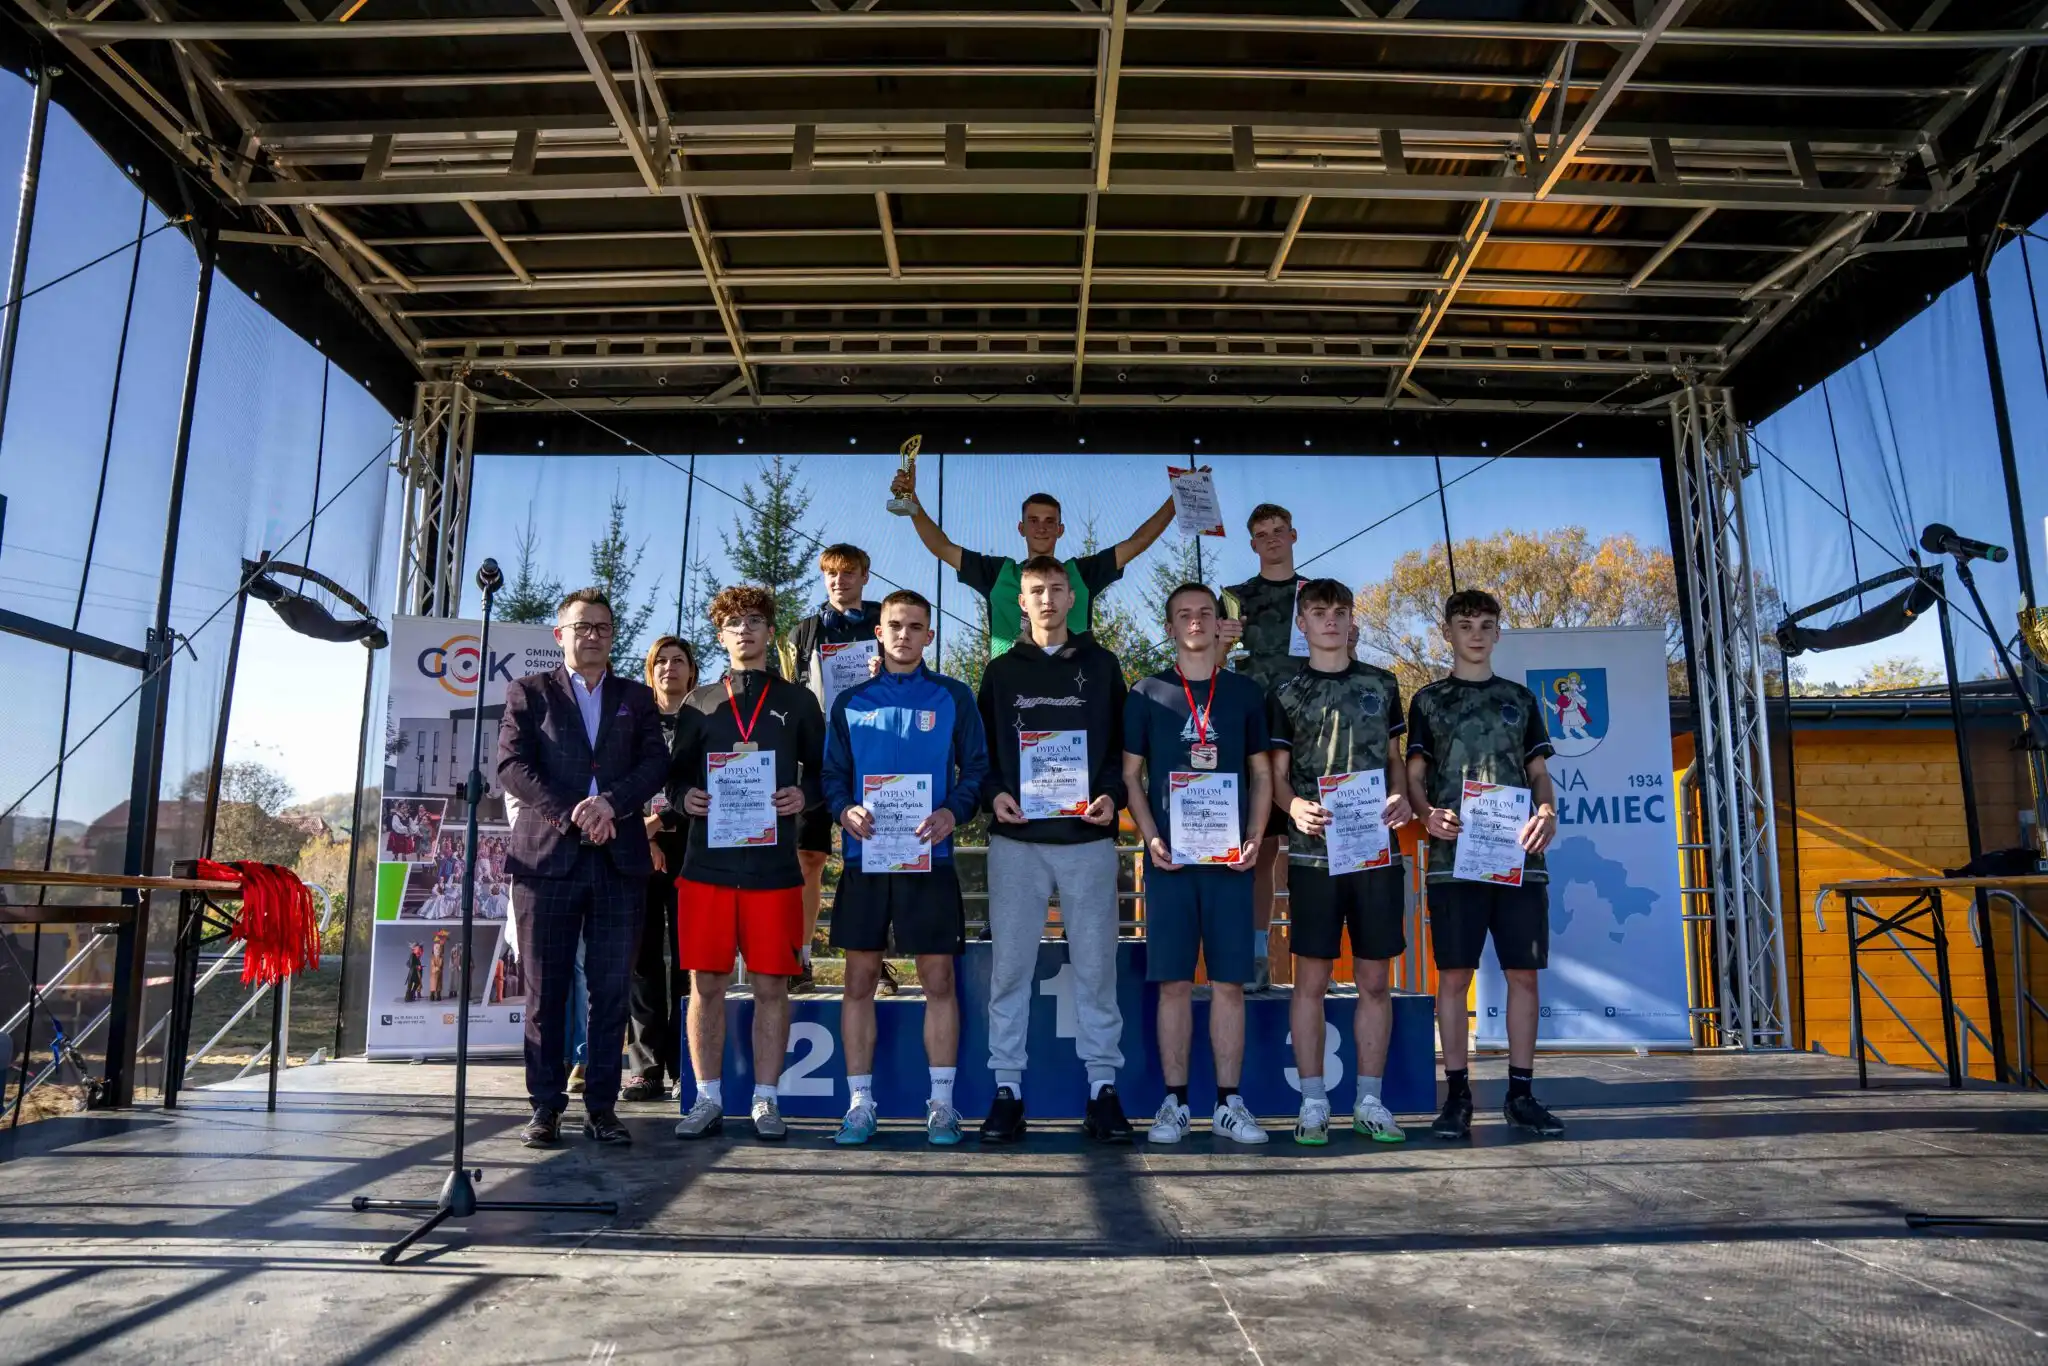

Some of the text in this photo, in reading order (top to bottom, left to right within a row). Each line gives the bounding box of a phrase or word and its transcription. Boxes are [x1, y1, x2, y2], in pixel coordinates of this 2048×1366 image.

[417, 647, 516, 683] GOK
[525, 657, 563, 669] OŚROD
[1036, 744, 1071, 753] DYPLOM
[724, 766, 760, 775] DYPLOM
[1549, 767, 1589, 791] NA
[1627, 774, 1664, 788] 1934
[879, 790, 915, 798] DYPLOM
[1186, 787, 1222, 797] DYPLOM
[1337, 786, 1371, 798] DYPLOM
[1478, 798, 1514, 810] DYPLOM
[1557, 794, 1665, 825] ŁMIEC
[1039, 963, 1078, 1038] 1
[776, 1021, 834, 1097] 2
[1283, 1021, 1344, 1093] 3
